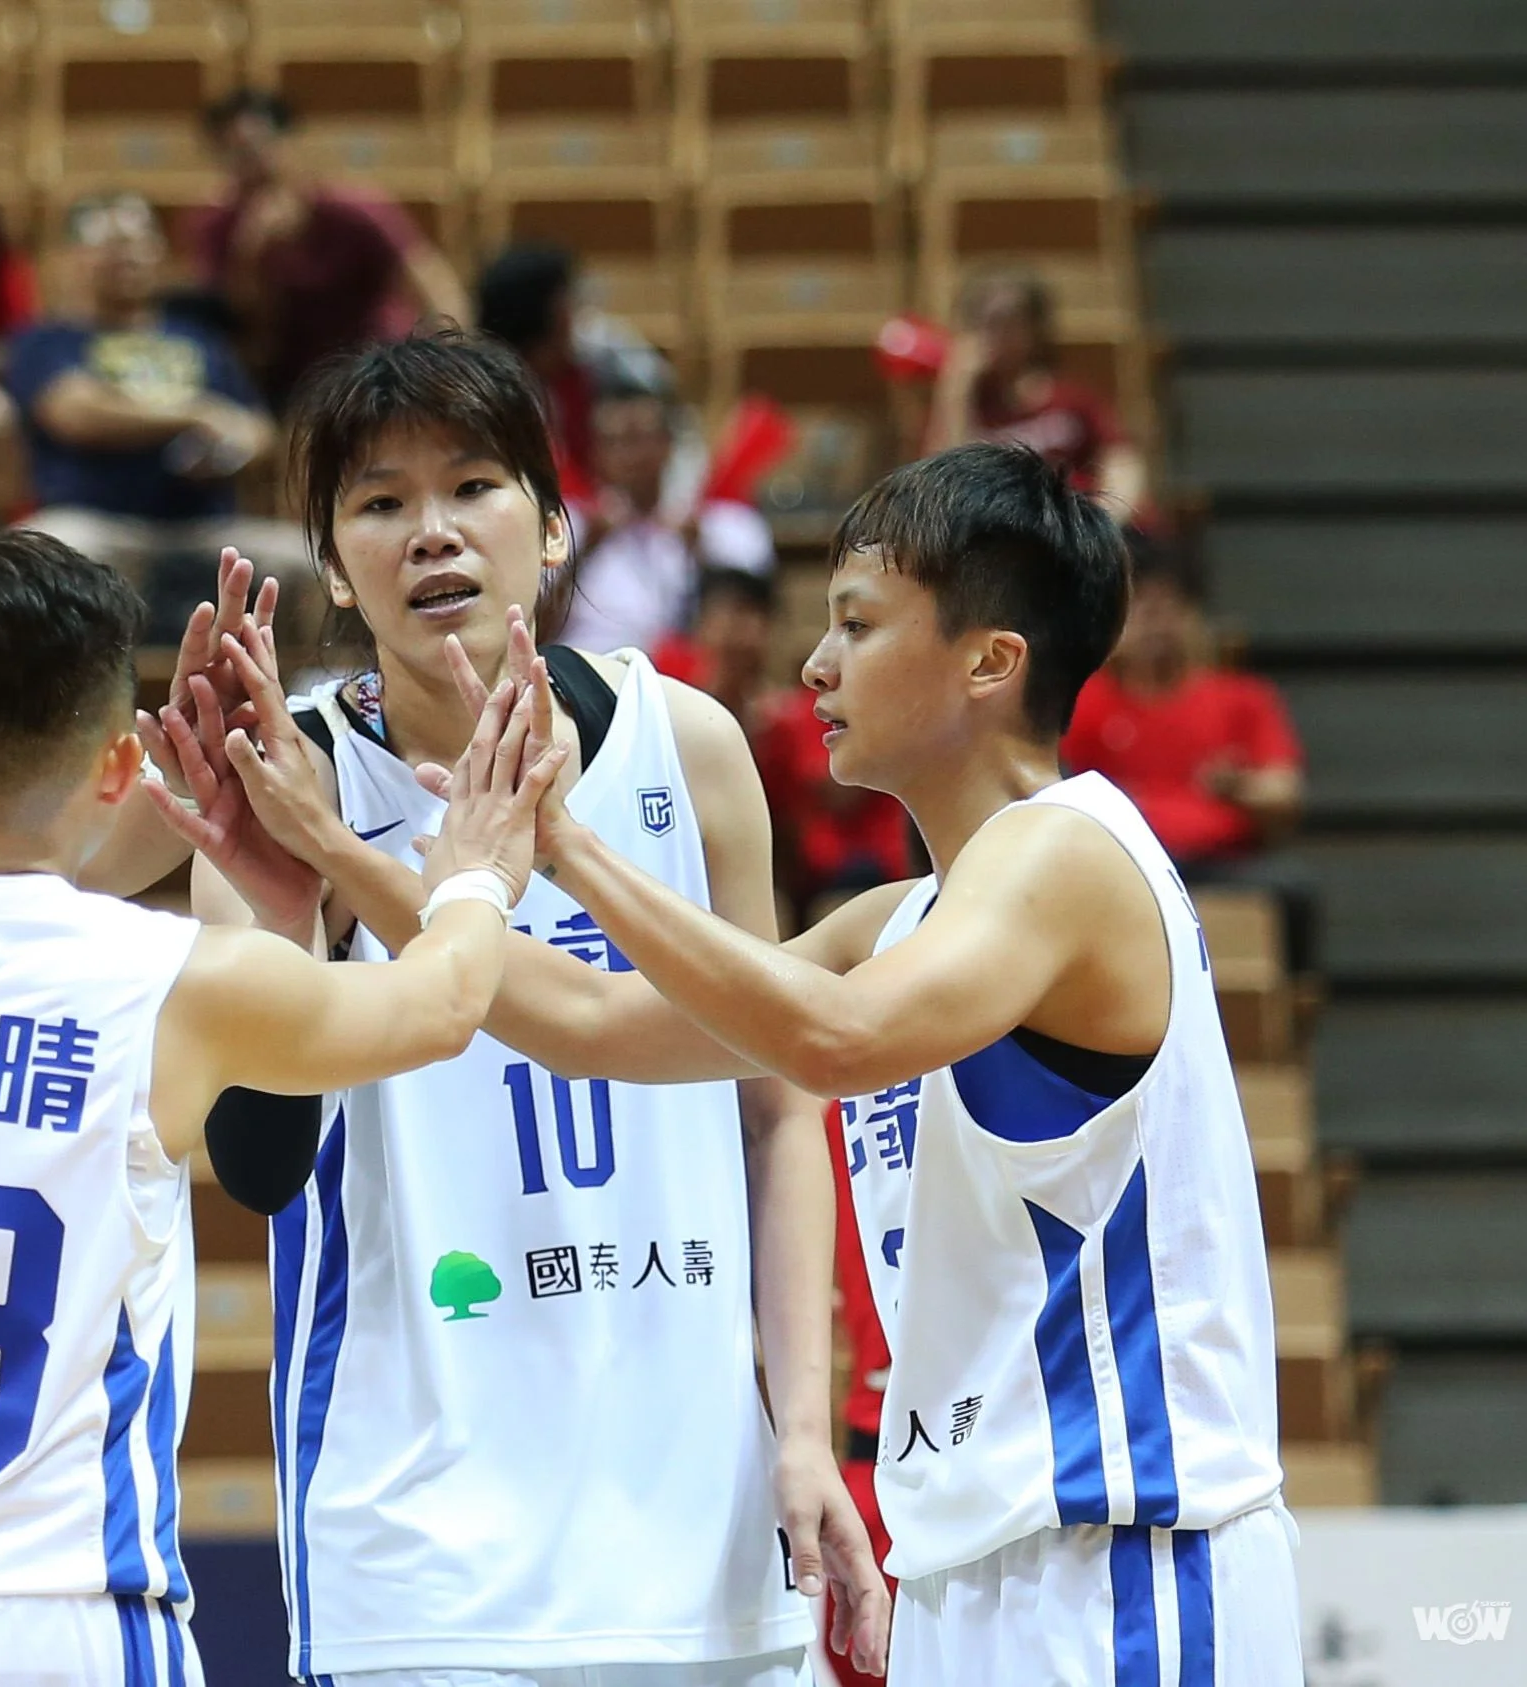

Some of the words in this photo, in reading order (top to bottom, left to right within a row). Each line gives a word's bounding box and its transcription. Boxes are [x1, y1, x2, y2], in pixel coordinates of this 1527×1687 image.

[503, 1062, 615, 1195] 10
[525, 1239, 715, 1299] 國泰人壽
